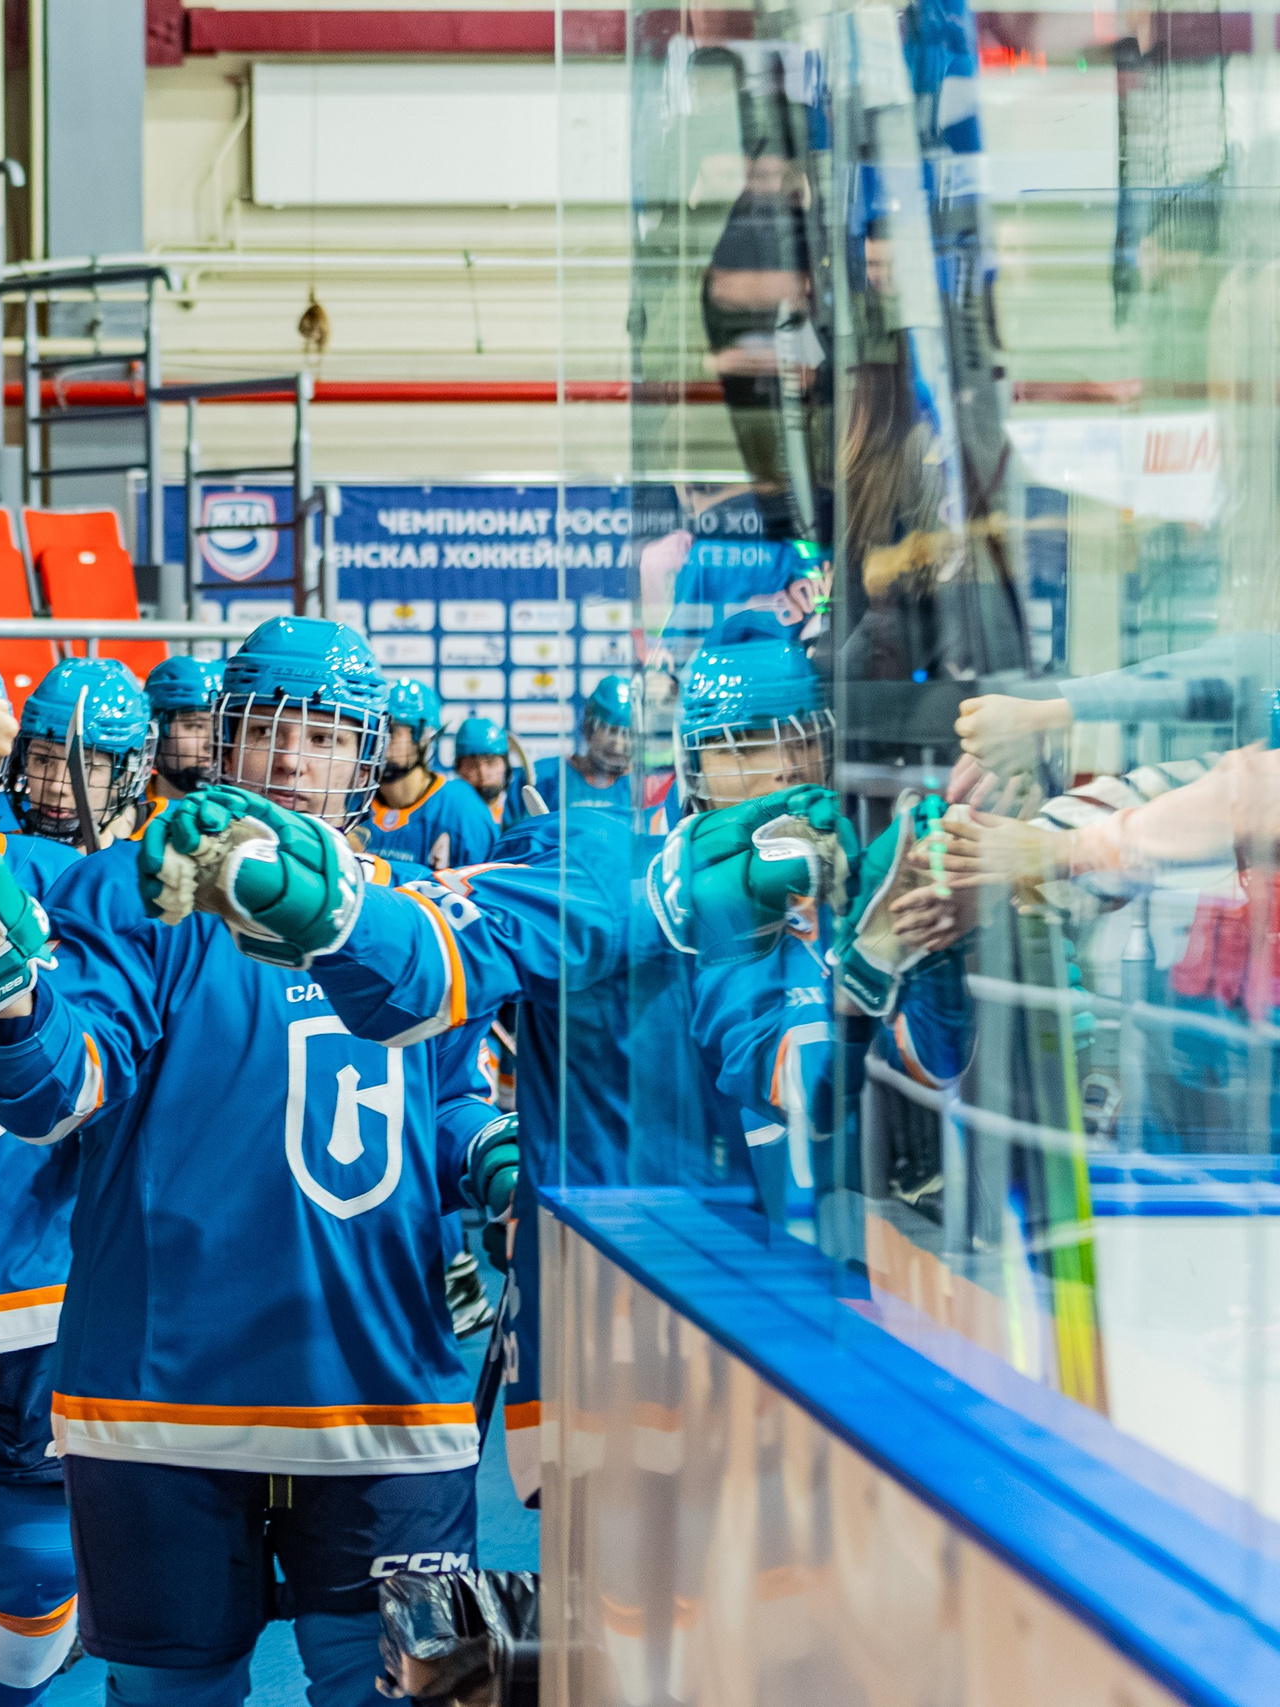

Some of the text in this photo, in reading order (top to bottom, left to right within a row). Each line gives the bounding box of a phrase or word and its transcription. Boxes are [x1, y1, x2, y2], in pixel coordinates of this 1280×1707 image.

[378, 508, 552, 535] ЧЕМПИОНАТ
[443, 538, 613, 569] ХОККЕЙНАЯ
[369, 1551, 470, 1579] CCM
